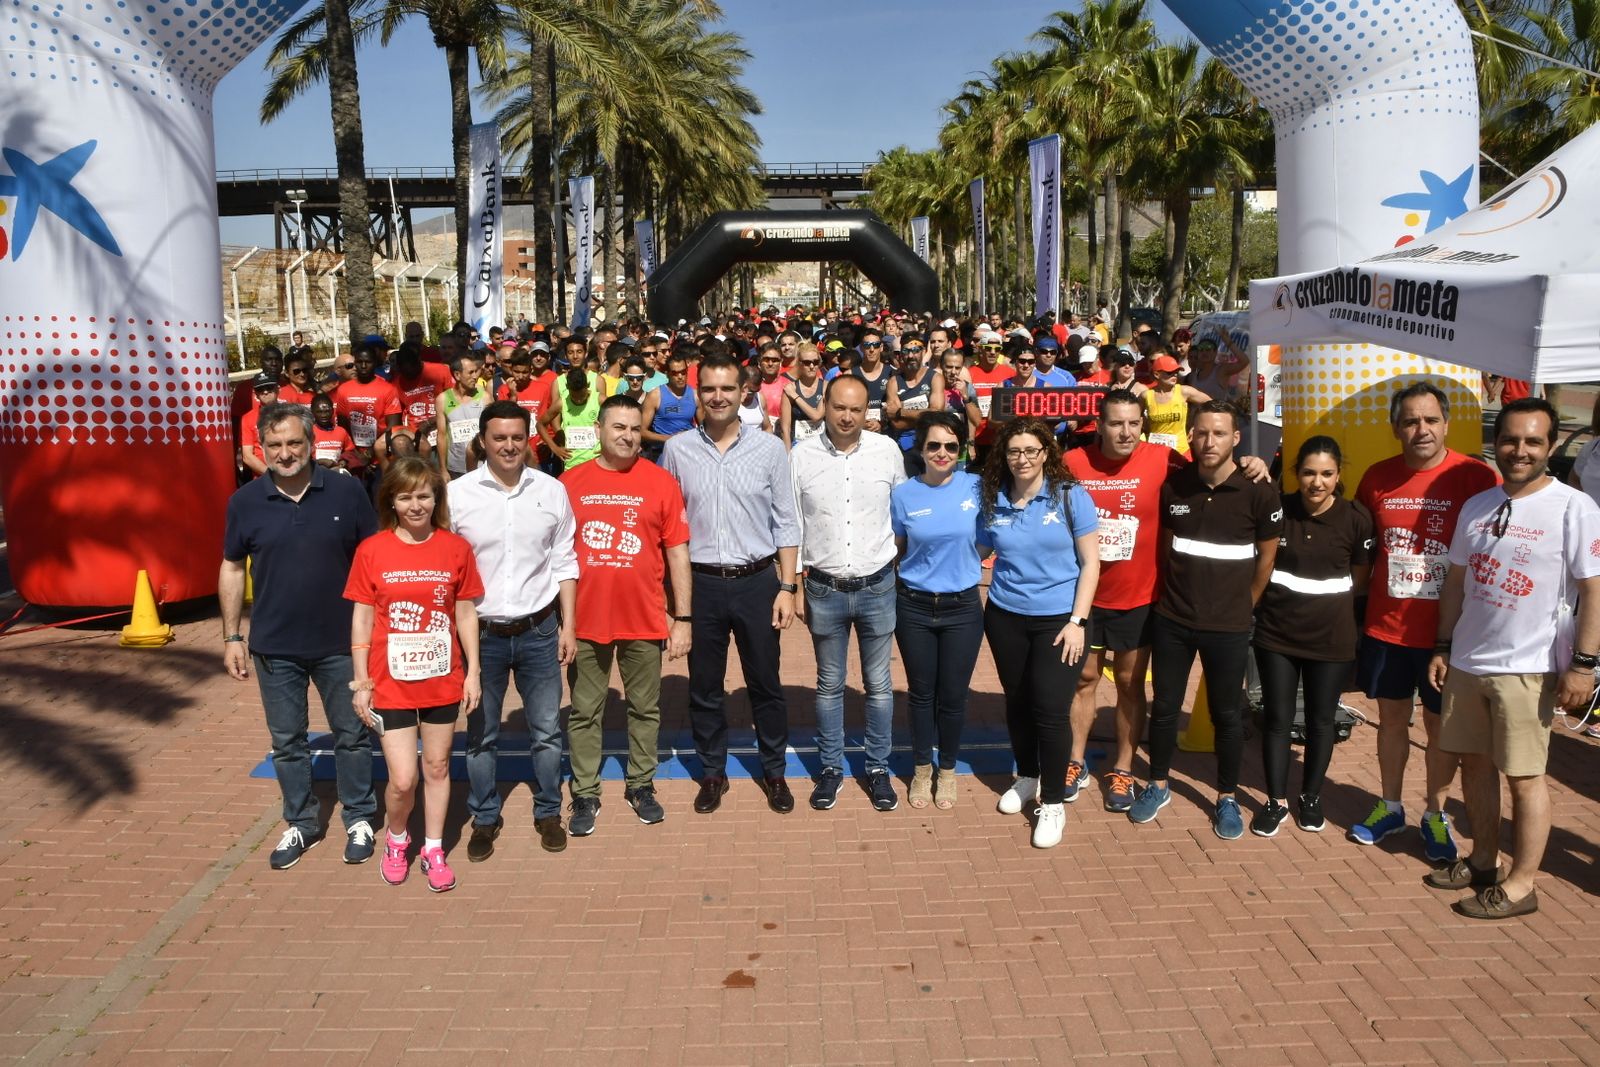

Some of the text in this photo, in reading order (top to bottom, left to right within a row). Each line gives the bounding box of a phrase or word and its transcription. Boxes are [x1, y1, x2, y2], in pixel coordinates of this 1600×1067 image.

[473, 160, 496, 309] CaixaBank
[765, 227, 850, 239] cruzandolameta
[1294, 267, 1460, 322] cruzandolameta
[1329, 307, 1455, 341] cronometraje deportivo
[580, 494, 644, 503] CARRERA POPULAR
[1383, 497, 1452, 506] CARRERA POPULAR
[382, 569, 452, 579] CARRERA POPULAR
[1399, 571, 1433, 583] 1499
[400, 651, 435, 663] 1270
